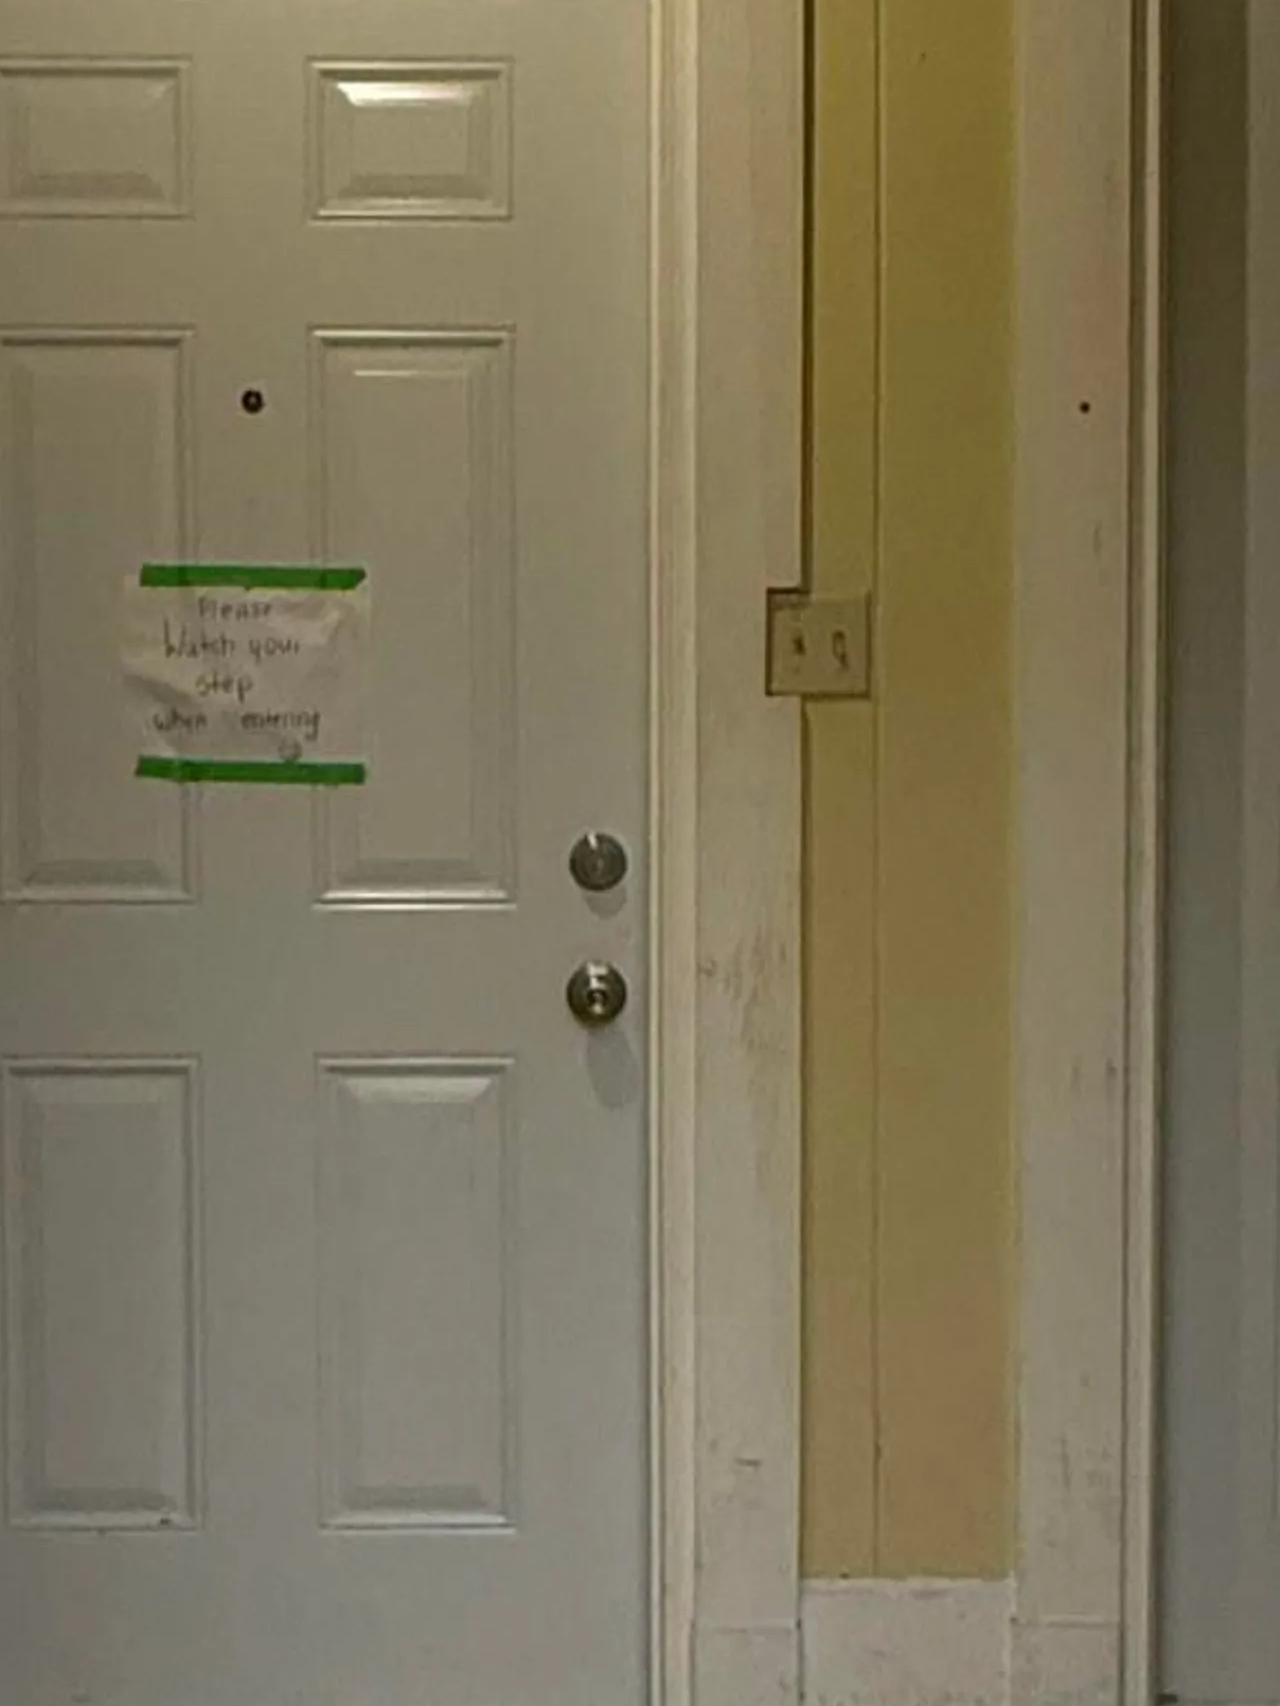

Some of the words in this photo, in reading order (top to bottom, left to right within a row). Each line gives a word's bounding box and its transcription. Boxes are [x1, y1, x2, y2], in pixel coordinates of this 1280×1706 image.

[163, 620, 235, 659] Watch
[249, 641, 300, 663] your
[241, 711, 321, 741] entering
